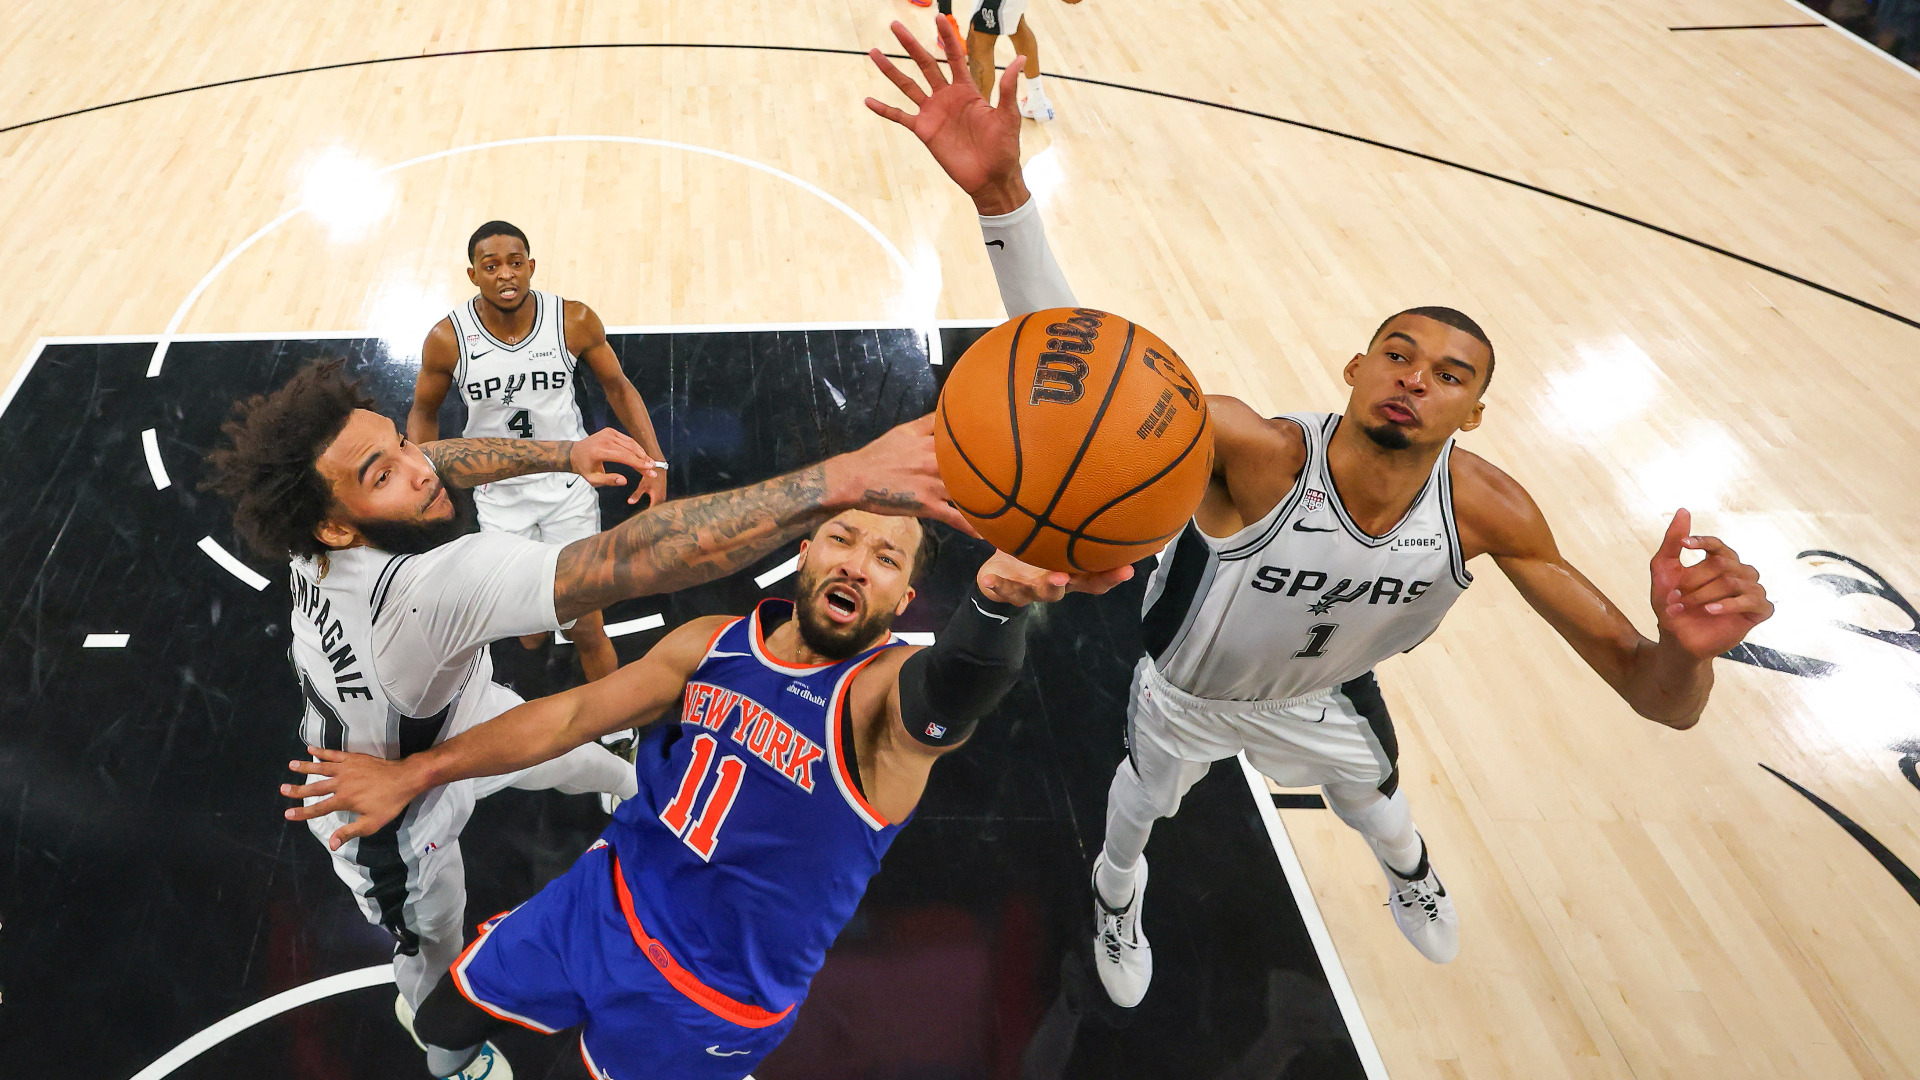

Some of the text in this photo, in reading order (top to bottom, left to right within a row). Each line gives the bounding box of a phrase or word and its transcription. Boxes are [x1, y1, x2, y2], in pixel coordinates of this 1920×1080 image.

[467, 371, 566, 406] SPURS
[505, 409, 534, 439] 4
[1136, 387, 1173, 440] OFFICIAL GAME BALL
[1307, 489, 1324, 500] USA
[1397, 538, 1436, 547] LEDGER
[1251, 565, 1433, 616] SPURS
[1290, 622, 1340, 660] 1
[786, 684, 800, 696] abu
[800, 689, 827, 707] dhabi
[681, 681, 825, 794] NEW YORK
[659, 732, 747, 863] 11
